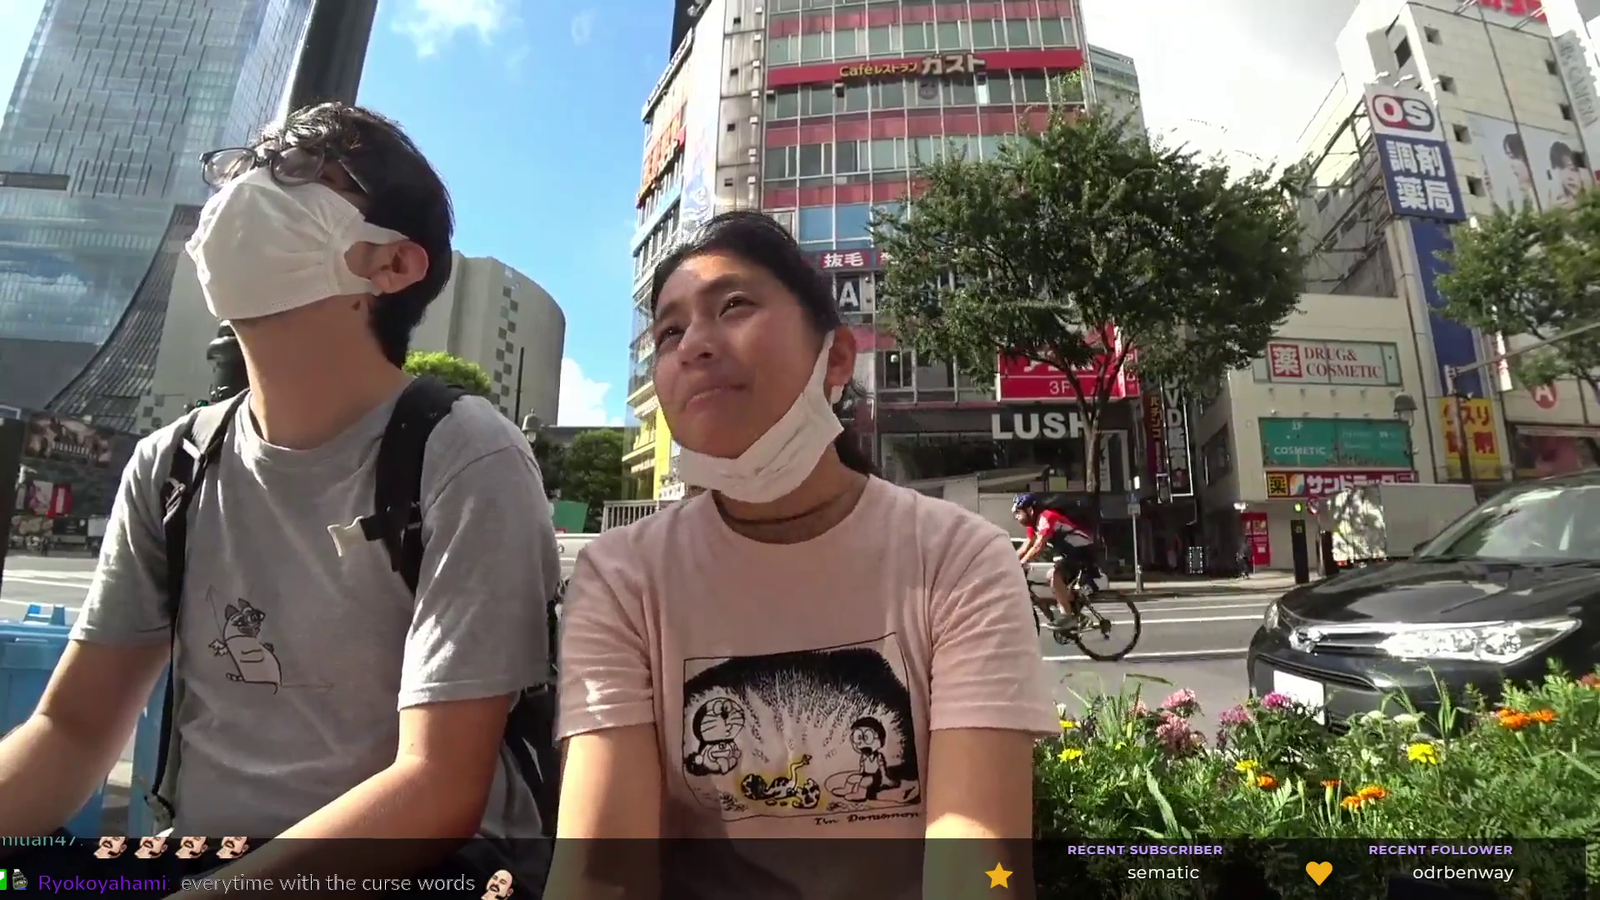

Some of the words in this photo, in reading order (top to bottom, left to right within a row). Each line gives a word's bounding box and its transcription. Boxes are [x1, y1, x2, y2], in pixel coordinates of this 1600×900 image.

[921, 53, 986, 76] ガスト
[1374, 95, 1433, 128] OS
[1386, 140, 1446, 178] 調剤
[1393, 175, 1455, 214] 薬局
[823, 252, 864, 269] 抜毛
[1304, 346, 1358, 362] DRUG&
[1306, 363, 1383, 379] COSMETIC
[1049, 380, 1071, 395] 3F
[991, 412, 1088, 440] LUSH
[1443, 405, 1491, 427] スリ
[1273, 446, 1327, 456] COSMETIC
[1268, 474, 1288, 496] 薬
